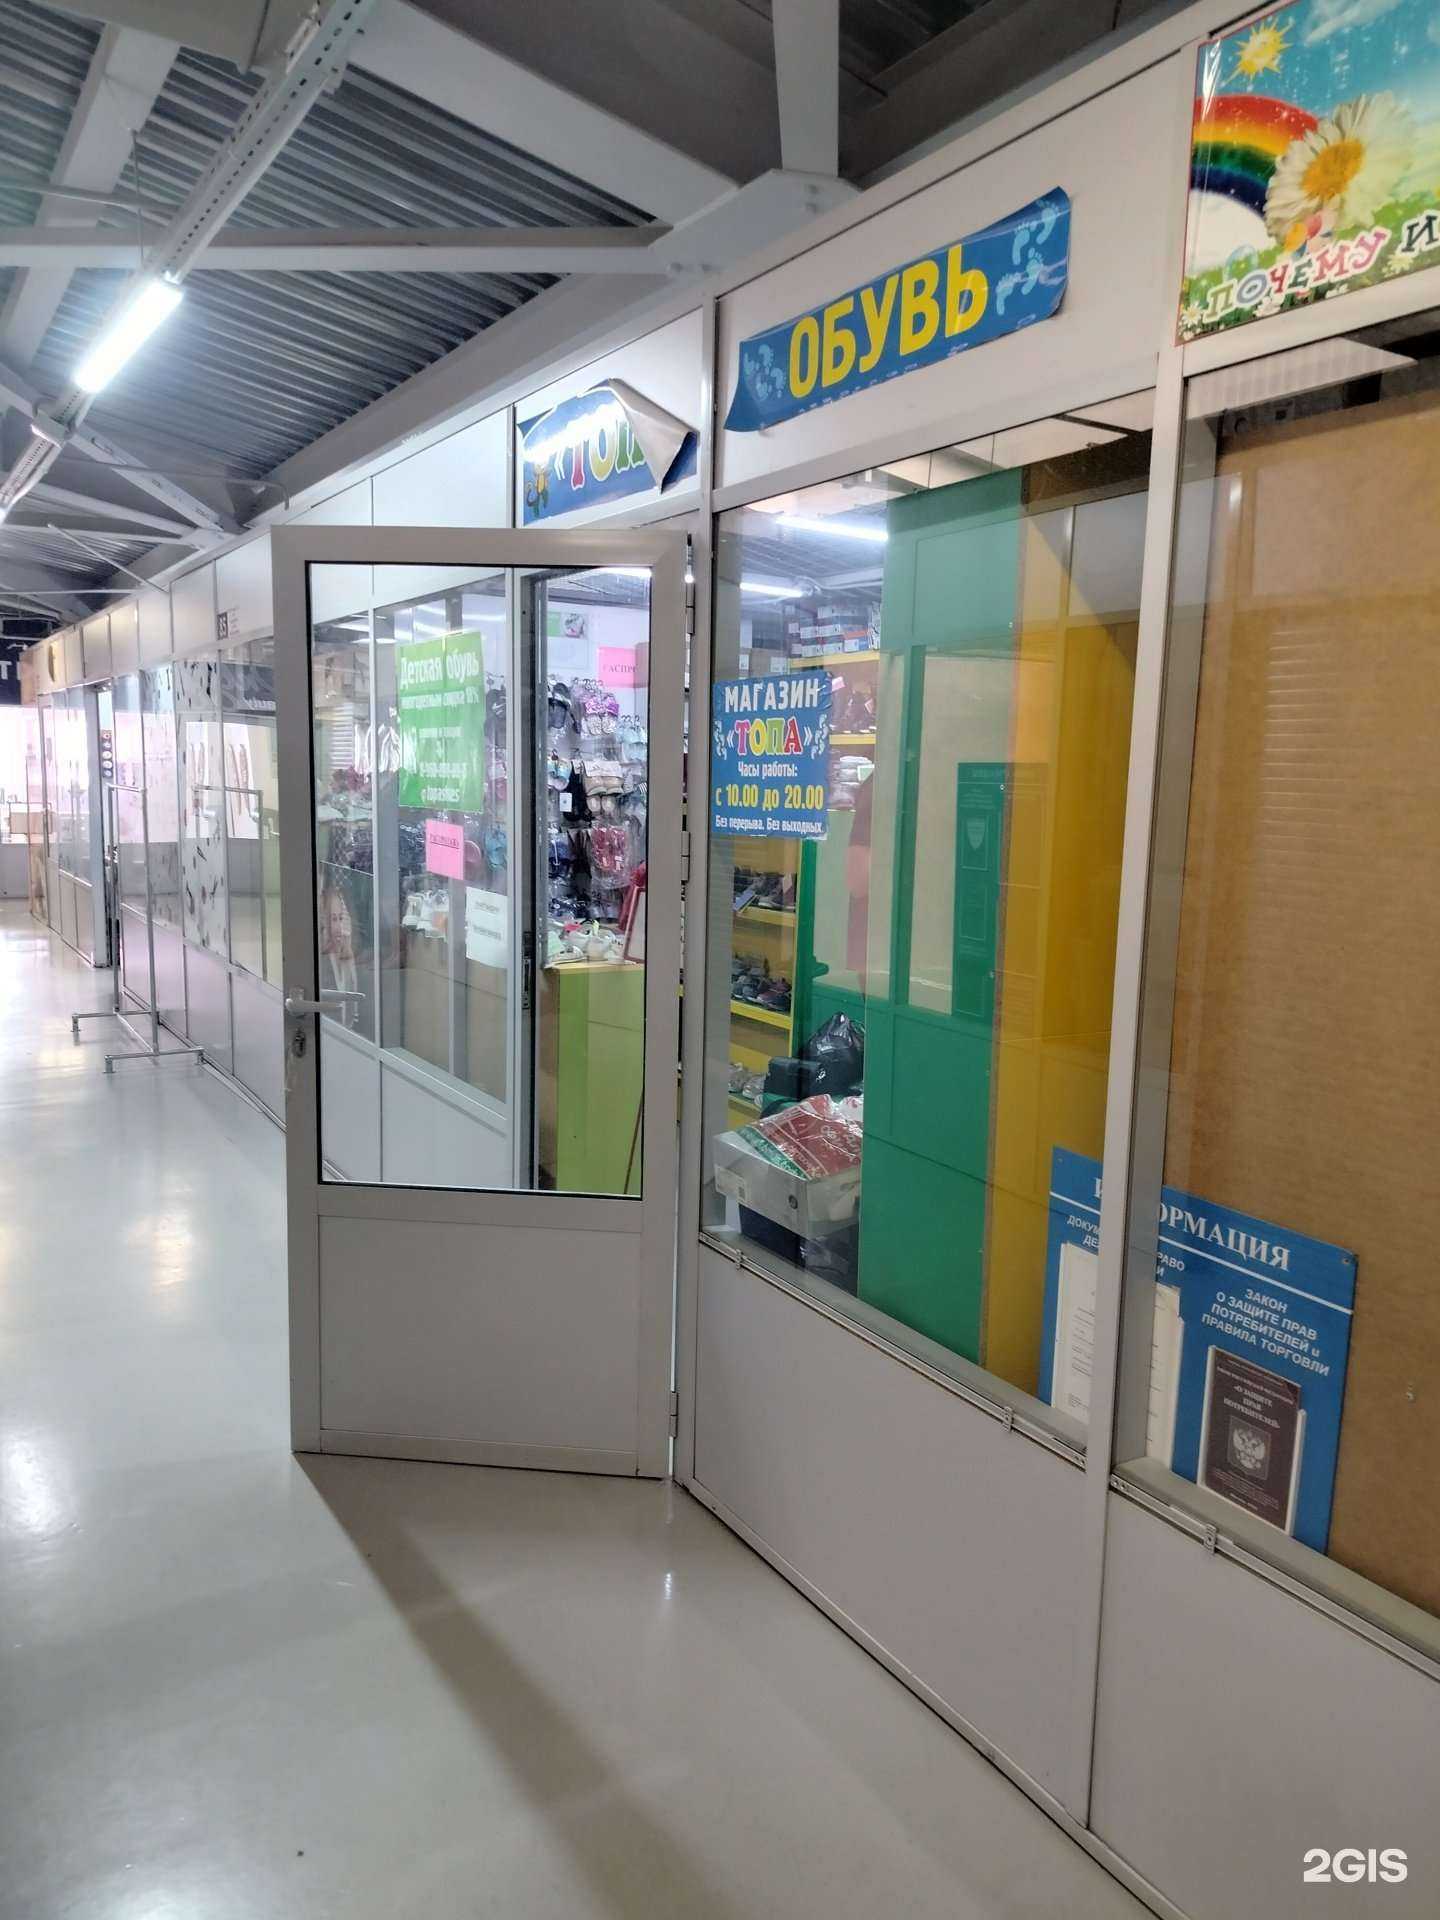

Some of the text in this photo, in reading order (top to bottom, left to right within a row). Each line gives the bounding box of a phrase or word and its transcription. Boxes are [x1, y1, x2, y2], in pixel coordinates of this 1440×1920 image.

[1203, 229, 1389, 320] ПОЧЕМУ
[789, 244, 988, 398] ОБУВЬ
[725, 678, 819, 713] МАГАЗИН
[726, 716, 813, 756] «ТОПА»
[738, 761, 798, 779] Часы работы:
[726, 784, 758, 808] 10.00
[762, 788, 780, 811] до
[784, 784, 824, 810] 20.00
[715, 815, 824, 834] Без перерыва. Без выходных.
[1215, 1291, 1318, 1342] О ЗАЩИТЕ ПРАВ
[1244, 1288, 1289, 1314] ЗАКОН
[1201, 1313, 1258, 1346] ПРАВИЛА
[1260, 1337, 1331, 1377] ТОРГОВЛИ
[1211, 1302, 1310, 1353] ПОТРЕБИТЕЛЕЙ
